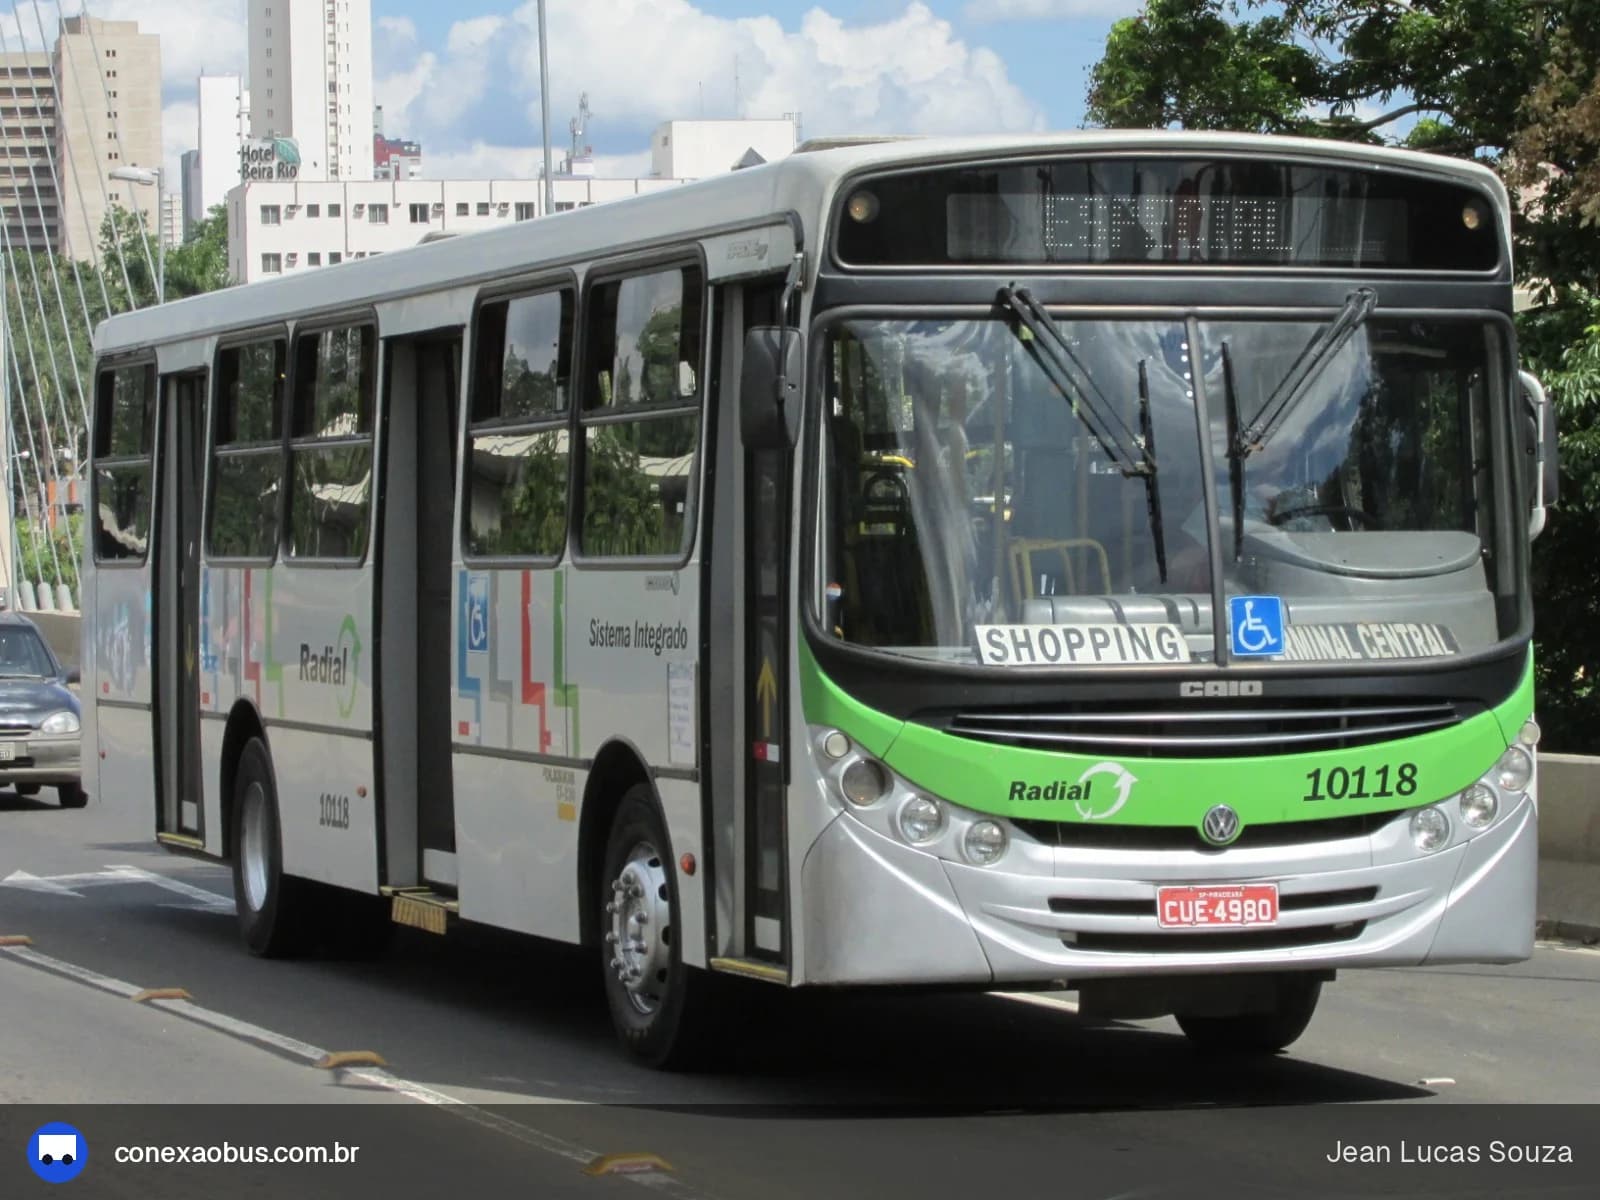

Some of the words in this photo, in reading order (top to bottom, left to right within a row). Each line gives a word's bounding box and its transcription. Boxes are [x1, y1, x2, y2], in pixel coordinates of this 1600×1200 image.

[241, 143, 274, 162] Hotel
[241, 162, 273, 179] Beira
[277, 161, 297, 178] Rio
[1045, 196, 1293, 250] ESPECIAL
[589, 618, 631, 648] Sistema
[633, 620, 688, 656] Integrado
[985, 627, 1180, 662] SHOPPING
[1272, 624, 1362, 660] RMINAL
[1356, 623, 1454, 658] CENTRAL
[299, 643, 348, 686] Radial
[1008, 780, 1092, 802] Radial
[1303, 763, 1418, 802] 10118
[319, 792, 350, 830] 10118
